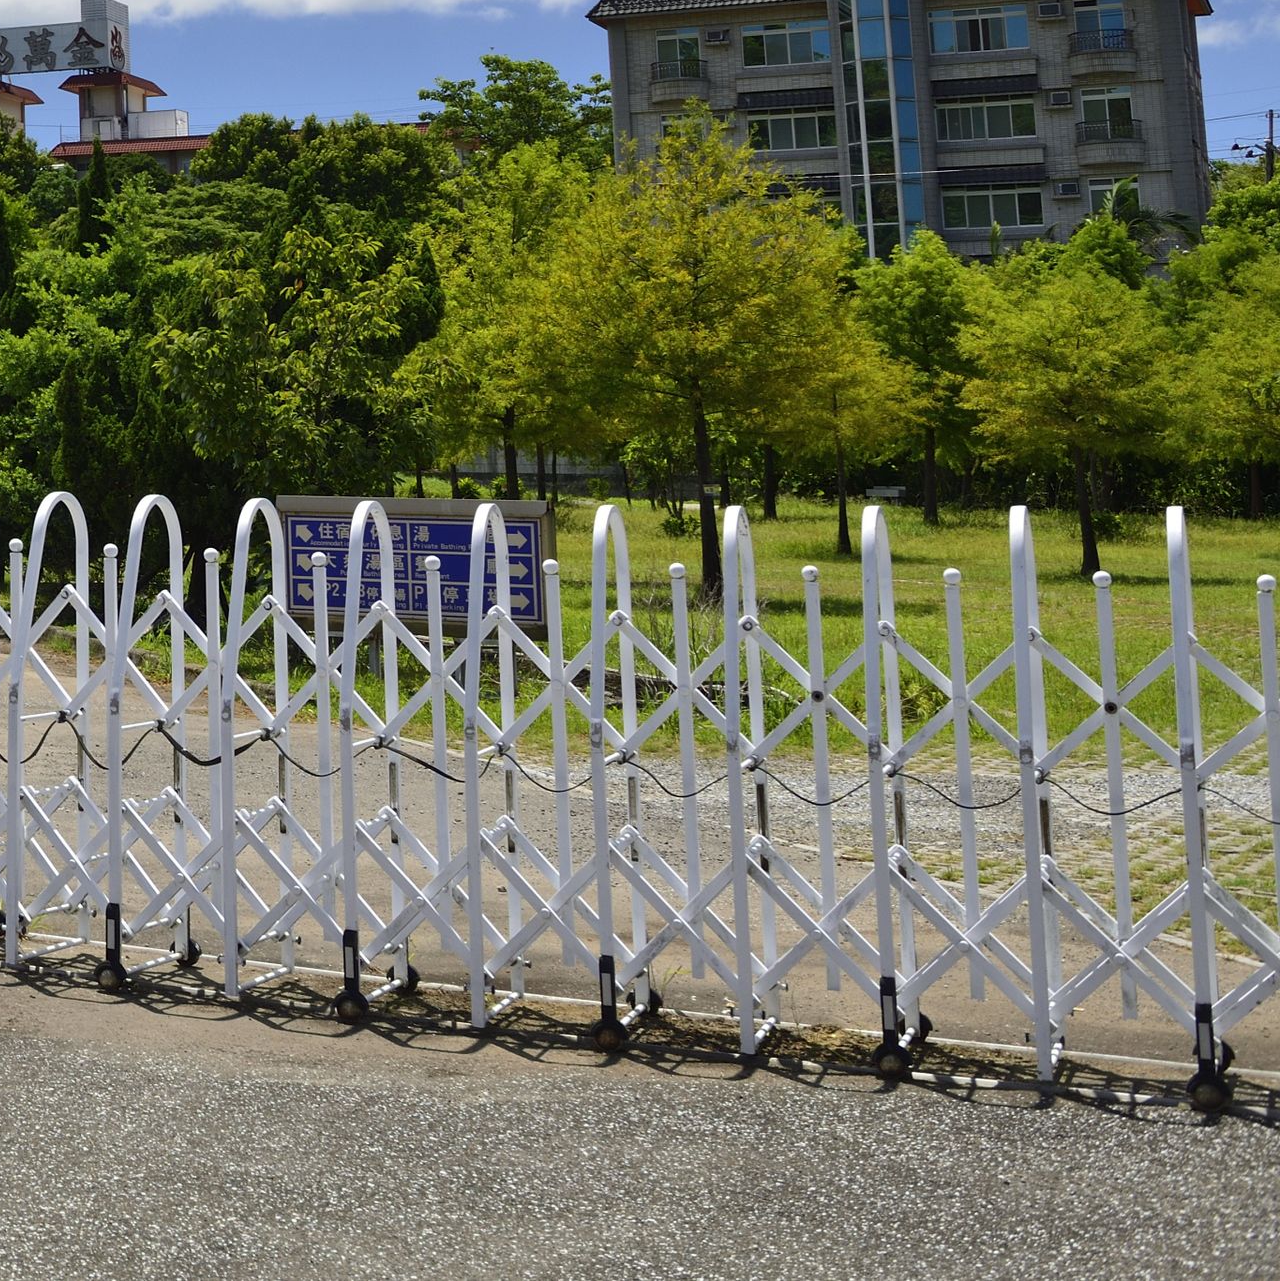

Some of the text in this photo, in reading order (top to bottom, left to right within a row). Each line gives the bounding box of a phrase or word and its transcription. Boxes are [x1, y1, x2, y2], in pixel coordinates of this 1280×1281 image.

[22, 27, 105, 71] 萬金
[413, 542, 439, 550] Private
[441, 543, 467, 552] Bathing
